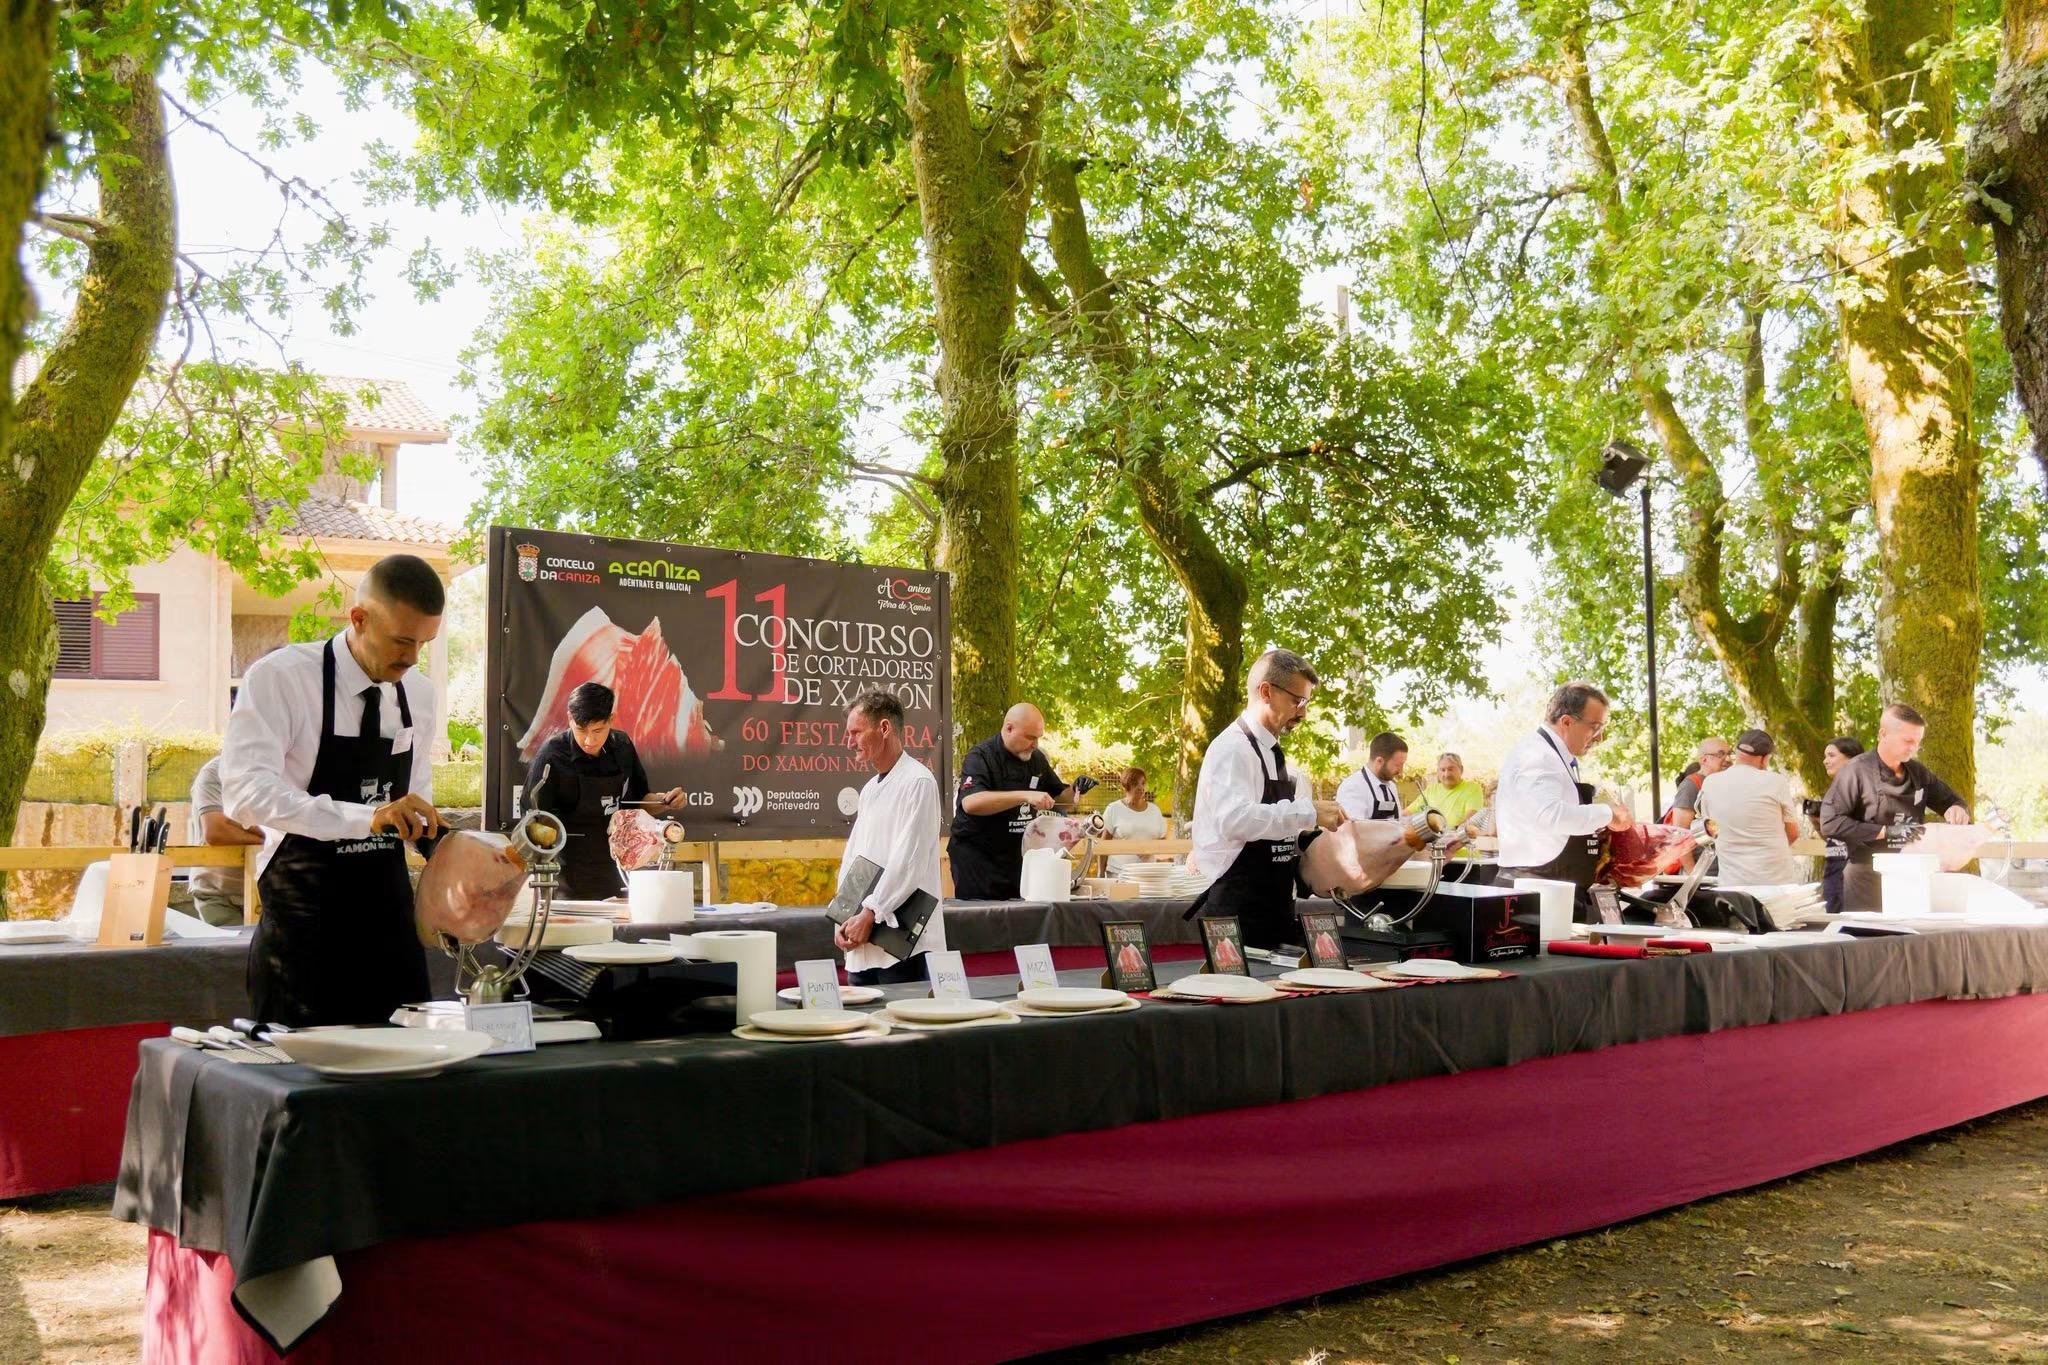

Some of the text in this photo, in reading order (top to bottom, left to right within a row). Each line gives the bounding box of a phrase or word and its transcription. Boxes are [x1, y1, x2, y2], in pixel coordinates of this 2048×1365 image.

[655, 581, 664, 590] EN
[705, 578, 803, 701] 11
[733, 613, 934, 659] CONCURSO
[771, 652, 934, 681] DE CORTADORES
[782, 678, 934, 710] DE XAÓN
[741, 716, 770, 742] 60
[742, 754, 770, 771] DO
[776, 753, 840, 772] XAMÓN
[766, 788, 820, 802] Deputación
[766, 801, 820, 811] Pontevedra
